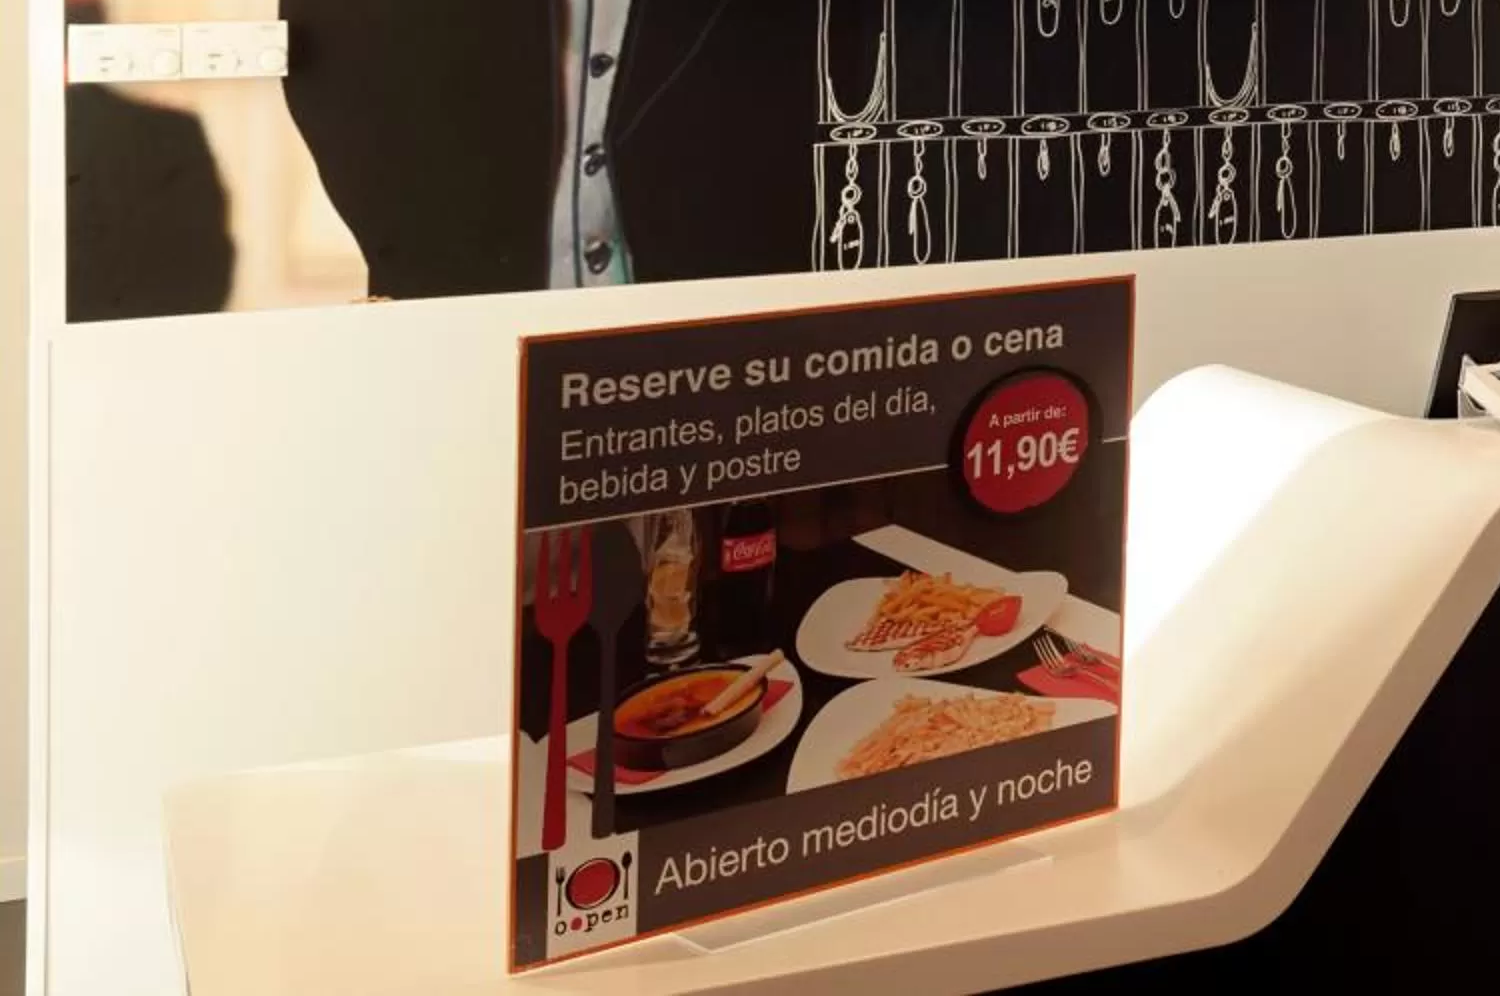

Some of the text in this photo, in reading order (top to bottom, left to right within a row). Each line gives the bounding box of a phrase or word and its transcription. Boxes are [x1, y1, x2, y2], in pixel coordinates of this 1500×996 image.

[560, 320, 1065, 409] Reserve su comida o cena
[560, 384, 936, 461] Entrantes, platos del día,
[988, 404, 1068, 428] A partir de:
[559, 444, 802, 505] bebida y postre
[966, 427, 1081, 480] 11,90€
[654, 755, 1095, 896] Abierto mediodía y noche
